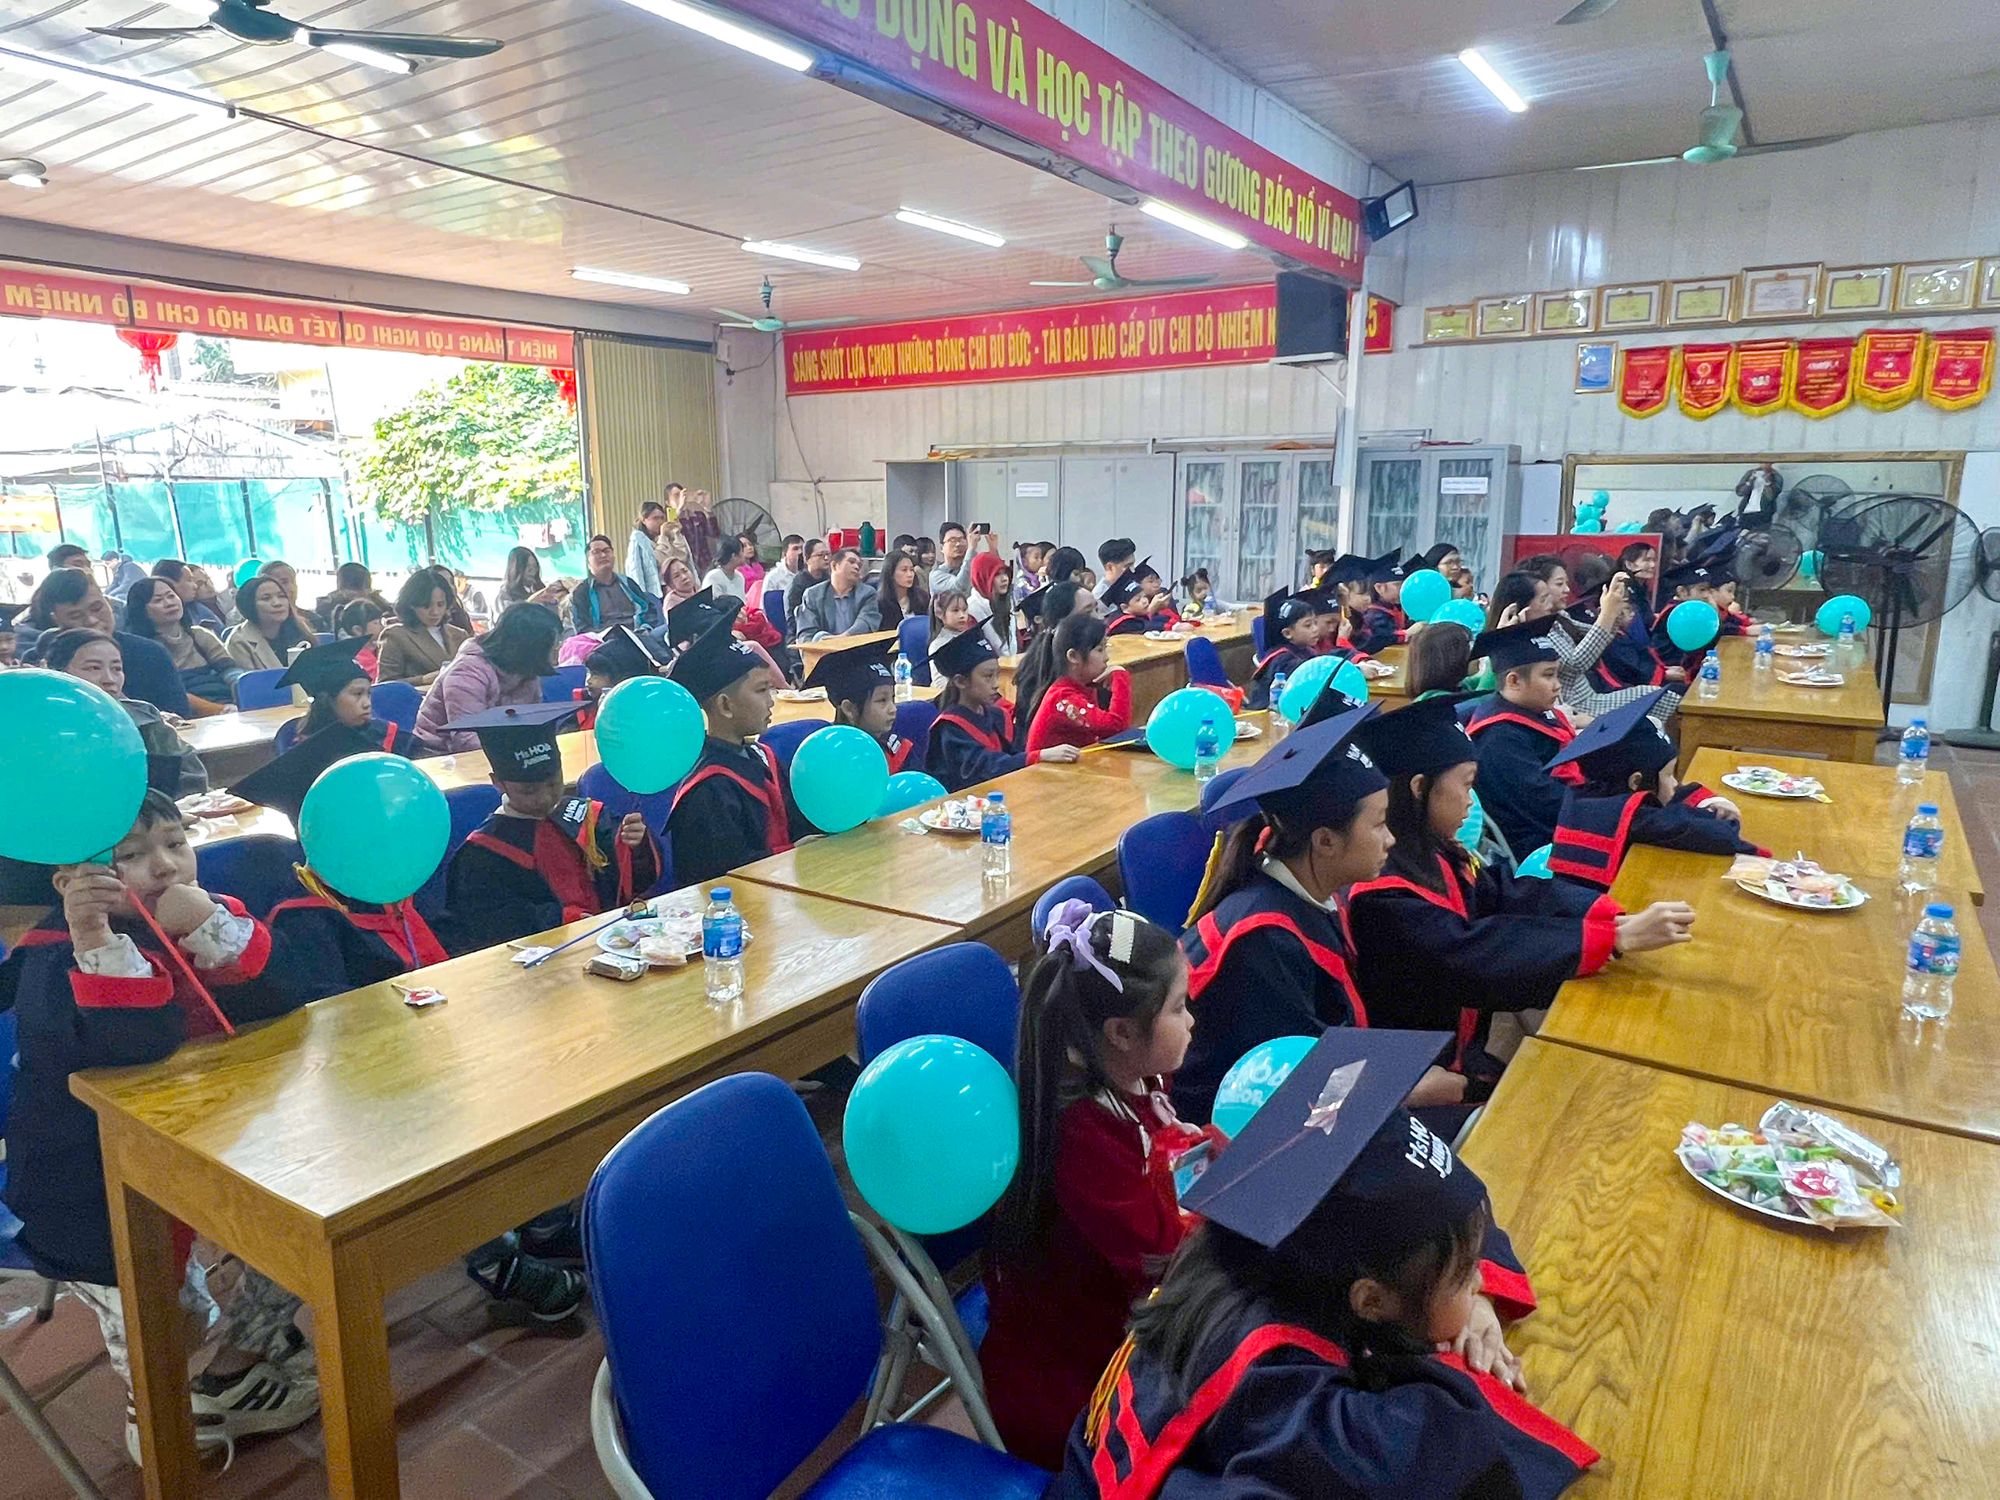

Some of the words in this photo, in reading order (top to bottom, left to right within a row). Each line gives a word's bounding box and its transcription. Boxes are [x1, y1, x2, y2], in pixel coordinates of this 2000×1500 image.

[987, 17, 1028, 106] VÀ
[1037, 47, 1090, 141] HỌC
[1098, 80, 1142, 168] TẬP
[1149, 112, 1198, 190] THEO
[1204, 145, 1261, 221] GƯƠNG
[1263, 174, 1293, 235] BÁC
[1296, 186, 1315, 244] HỒ
[1317, 200, 1331, 251] VĨ
[792, 344, 818, 383] SÁNG
[820, 336, 844, 380] SUỐT
[846, 343, 866, 386] LỰA
[867, 343, 896, 384] CHỌN
[896, 334, 934, 375] NHỮNG
[968, 328, 987, 370] CHÍ
[1091, 315, 1116, 360] VÀO
[1120, 306, 1145, 358] CẤP
[1169, 315, 1192, 354] CHI
[1195, 305, 1213, 360] BỘ
[1217, 301, 1263, 357] NHIỆM
